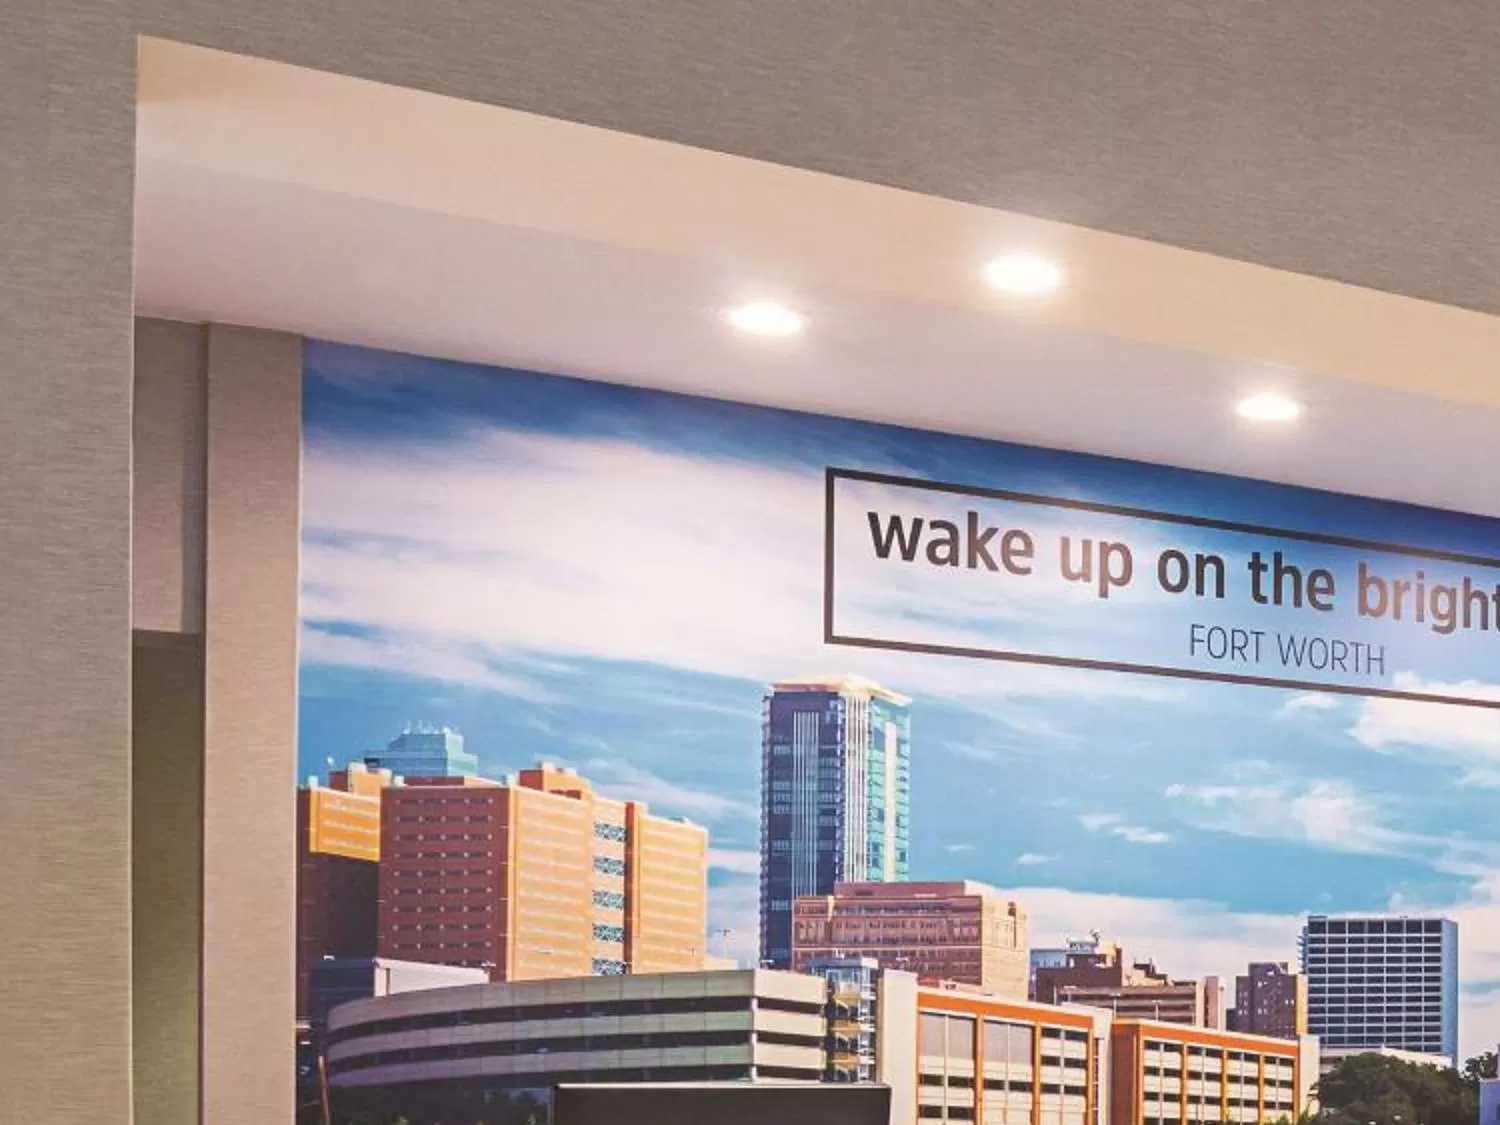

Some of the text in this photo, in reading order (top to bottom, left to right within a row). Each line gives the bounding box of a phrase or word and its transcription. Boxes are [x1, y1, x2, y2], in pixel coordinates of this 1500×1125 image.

[867, 510, 1034, 576] wake
[1060, 536, 1133, 599] up
[1157, 549, 1225, 599] on
[1248, 551, 1335, 612] the
[1190, 624, 1385, 676] FORT WORTH
